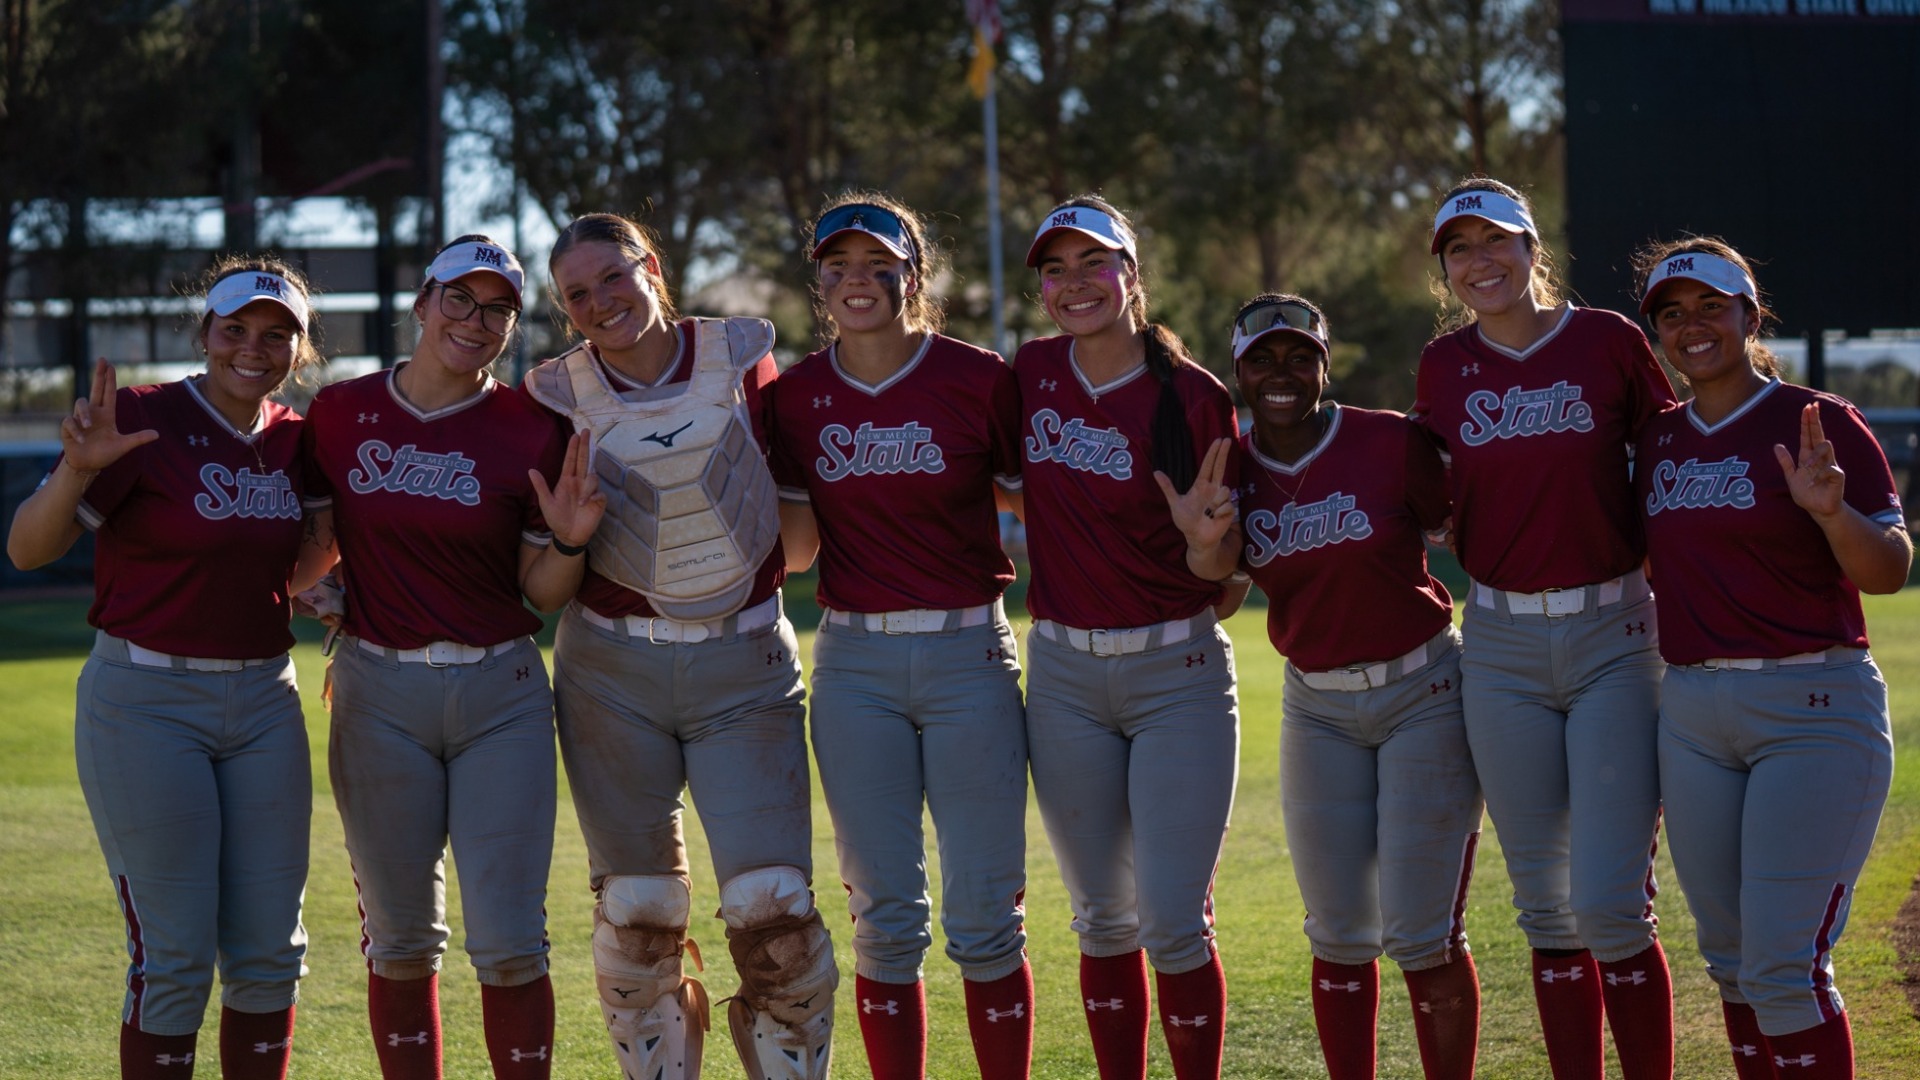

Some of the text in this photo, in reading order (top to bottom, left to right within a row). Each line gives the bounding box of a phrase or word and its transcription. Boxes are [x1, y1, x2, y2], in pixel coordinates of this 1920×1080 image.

[1460, 380, 1595, 446] State
[1507, 389, 1577, 405] NEW MEXICO
[398, 453, 470, 470] NEW MEXICO
[816, 421, 946, 482] State
[858, 431, 928, 440] NEW MEXICO
[1025, 408, 1133, 480] State
[1066, 426, 1126, 445] NEW MEXICO
[194, 462, 302, 521] State
[348, 439, 481, 506] State
[1646, 455, 1756, 517] State
[1680, 465, 1744, 475] NEW MEXICO
[1245, 491, 1374, 568] State
[1283, 499, 1352, 521] NEW MEXICO
